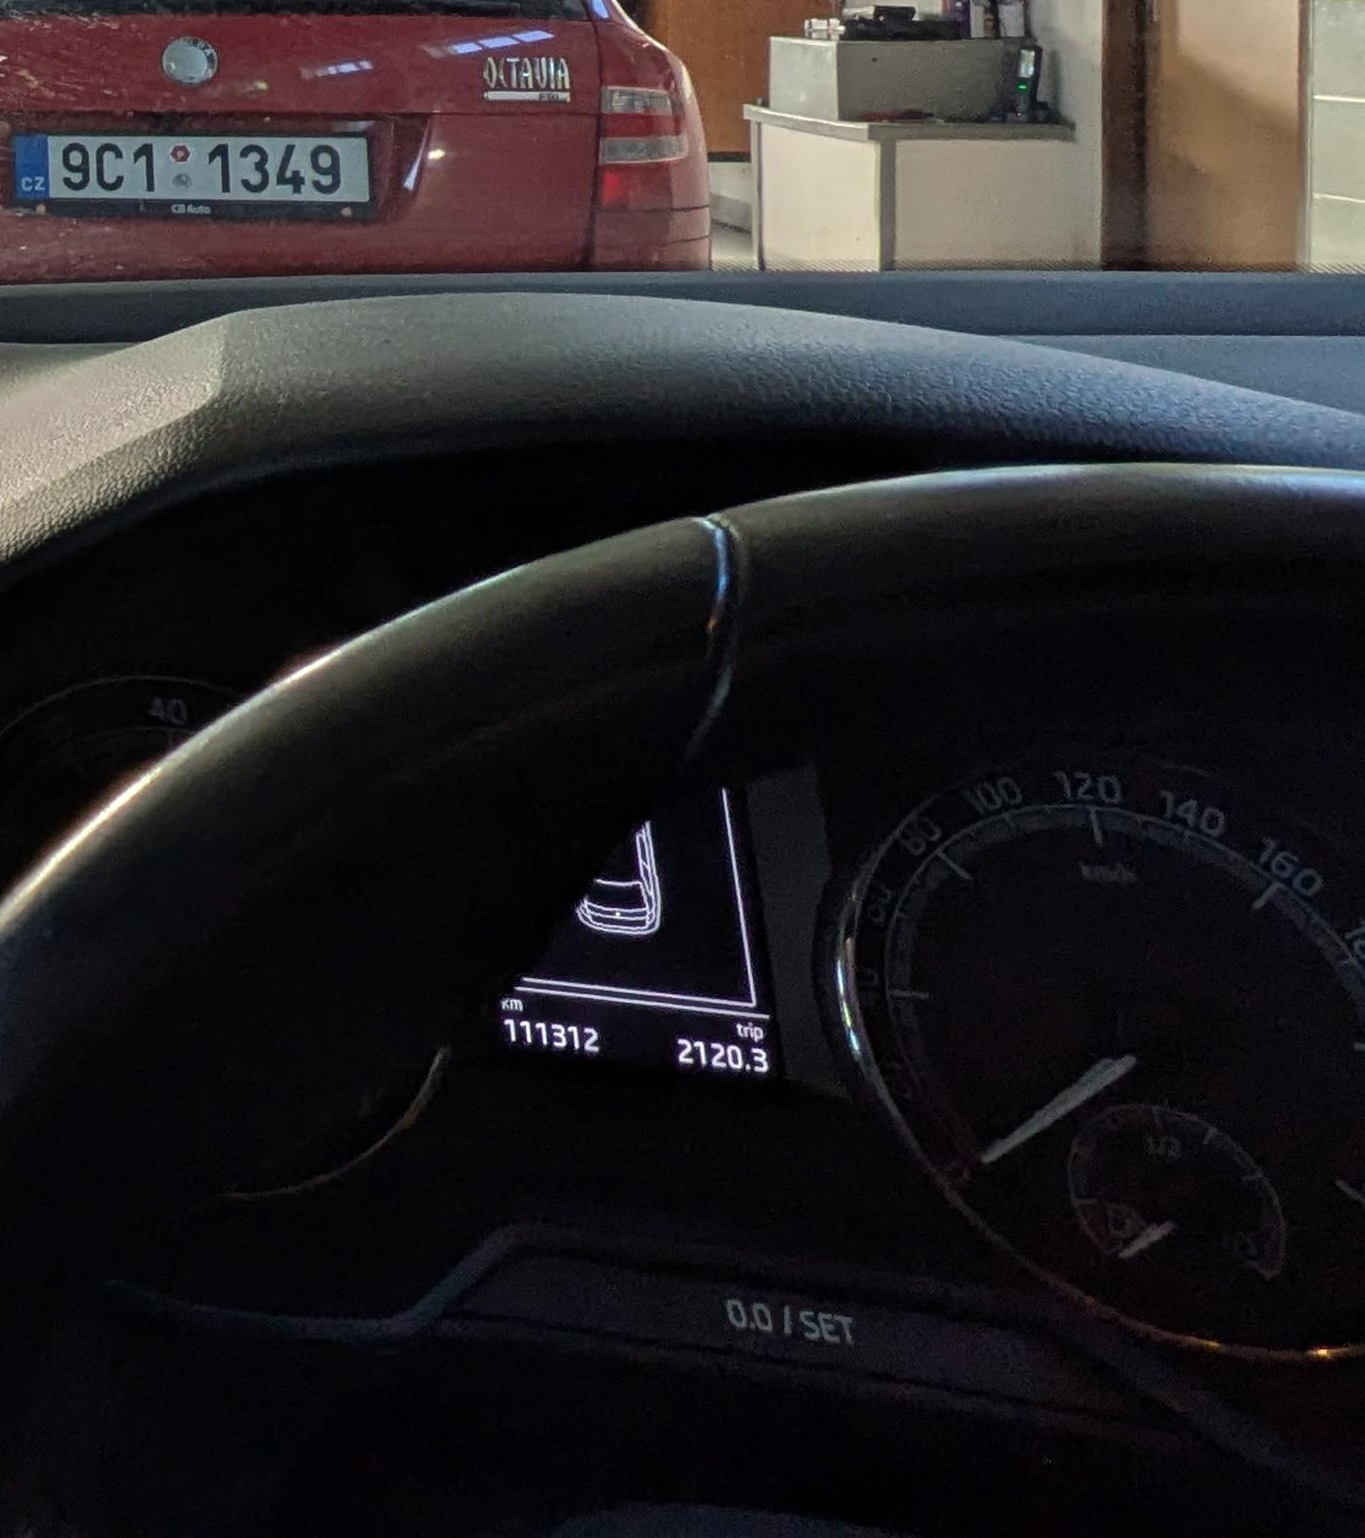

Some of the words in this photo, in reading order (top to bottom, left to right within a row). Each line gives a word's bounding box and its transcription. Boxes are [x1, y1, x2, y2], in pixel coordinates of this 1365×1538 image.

[21, 174, 45, 191] CZ
[61, 142, 155, 193] 9C1
[207, 142, 342, 194] 1349
[968, 775, 1024, 816] 100
[1053, 770, 1124, 805] 120
[1159, 790, 1226, 838] 140
[1259, 836, 1324, 898] 160
[501, 998, 524, 1012] km
[503, 1018, 600, 1053] 111312
[677, 1039, 770, 1073] 2120.3
[736, 1022, 765, 1041] trip
[799, 1311, 855, 1346] SET
